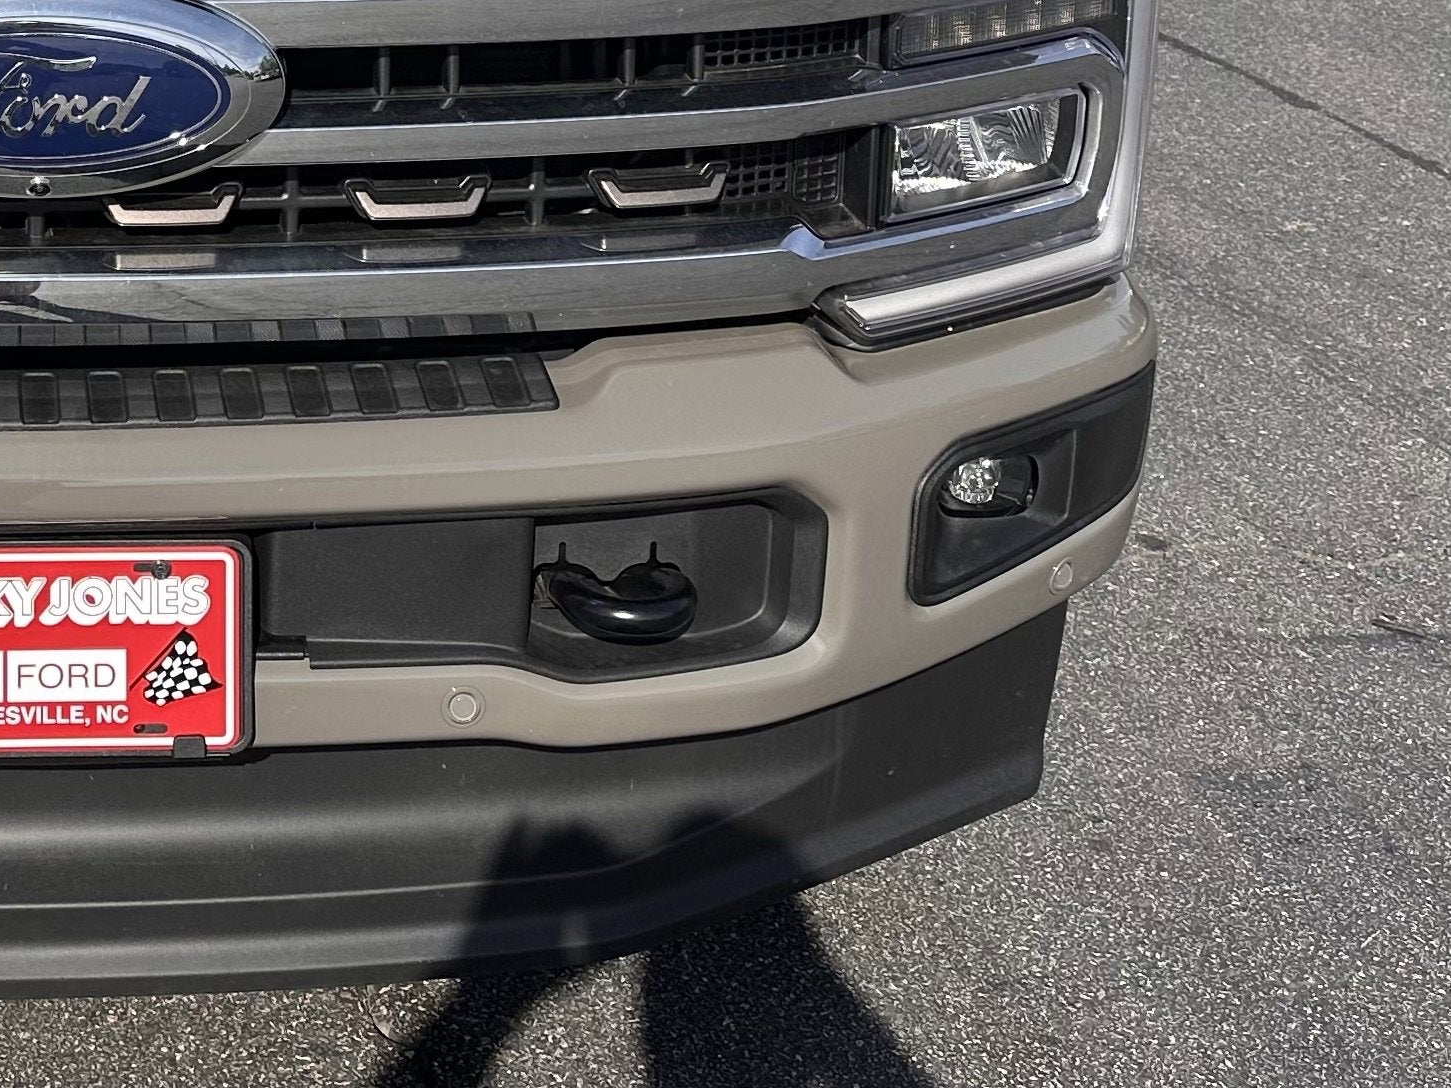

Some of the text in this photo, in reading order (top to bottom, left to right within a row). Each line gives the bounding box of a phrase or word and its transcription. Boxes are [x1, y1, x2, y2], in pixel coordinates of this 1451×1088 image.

[39, 575, 211, 626] JONES
[17, 663, 116, 689] FORD
[96, 704, 129, 724] NC
